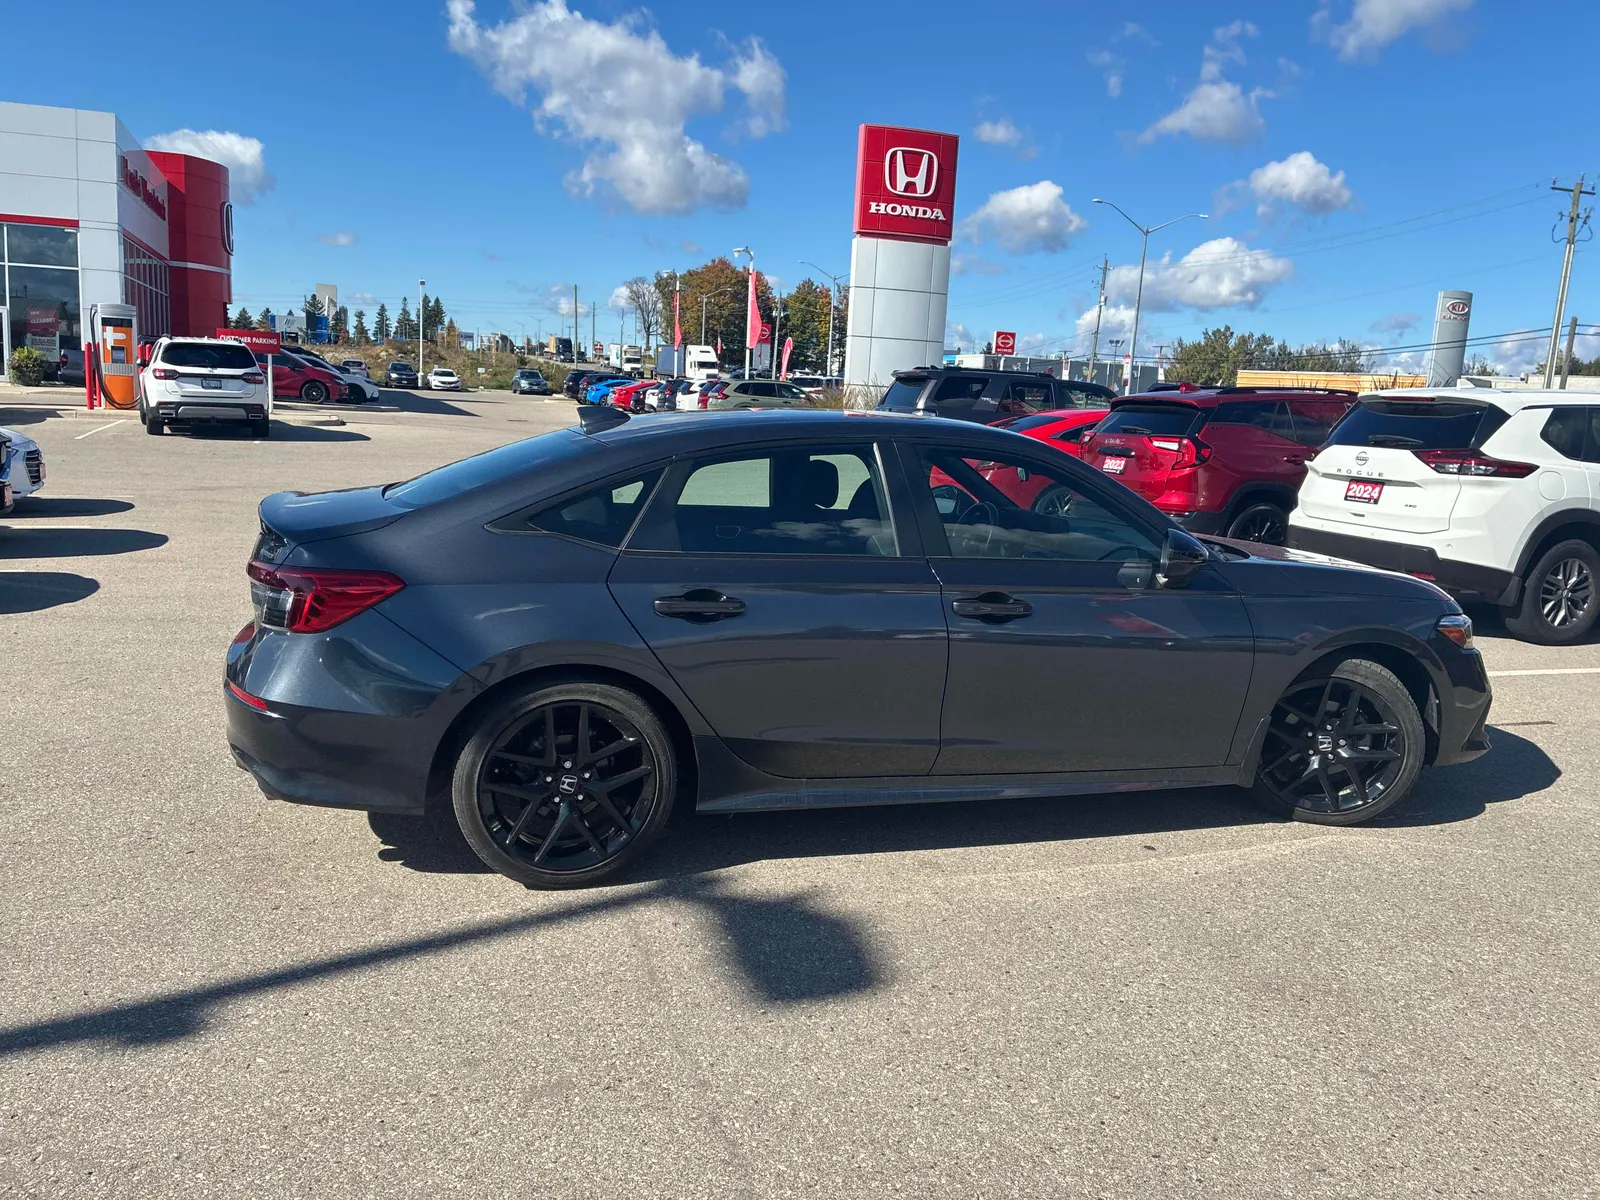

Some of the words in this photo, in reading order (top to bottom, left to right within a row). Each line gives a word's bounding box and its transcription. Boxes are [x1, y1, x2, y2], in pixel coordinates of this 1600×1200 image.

[869, 202, 946, 220] HONDA
[1451, 303, 1467, 312] KIA
[252, 337, 277, 345] PARKING
[1103, 459, 1125, 470] 2023
[1336, 468, 1384, 477] ROGUE
[1346, 484, 1380, 499] 2024
